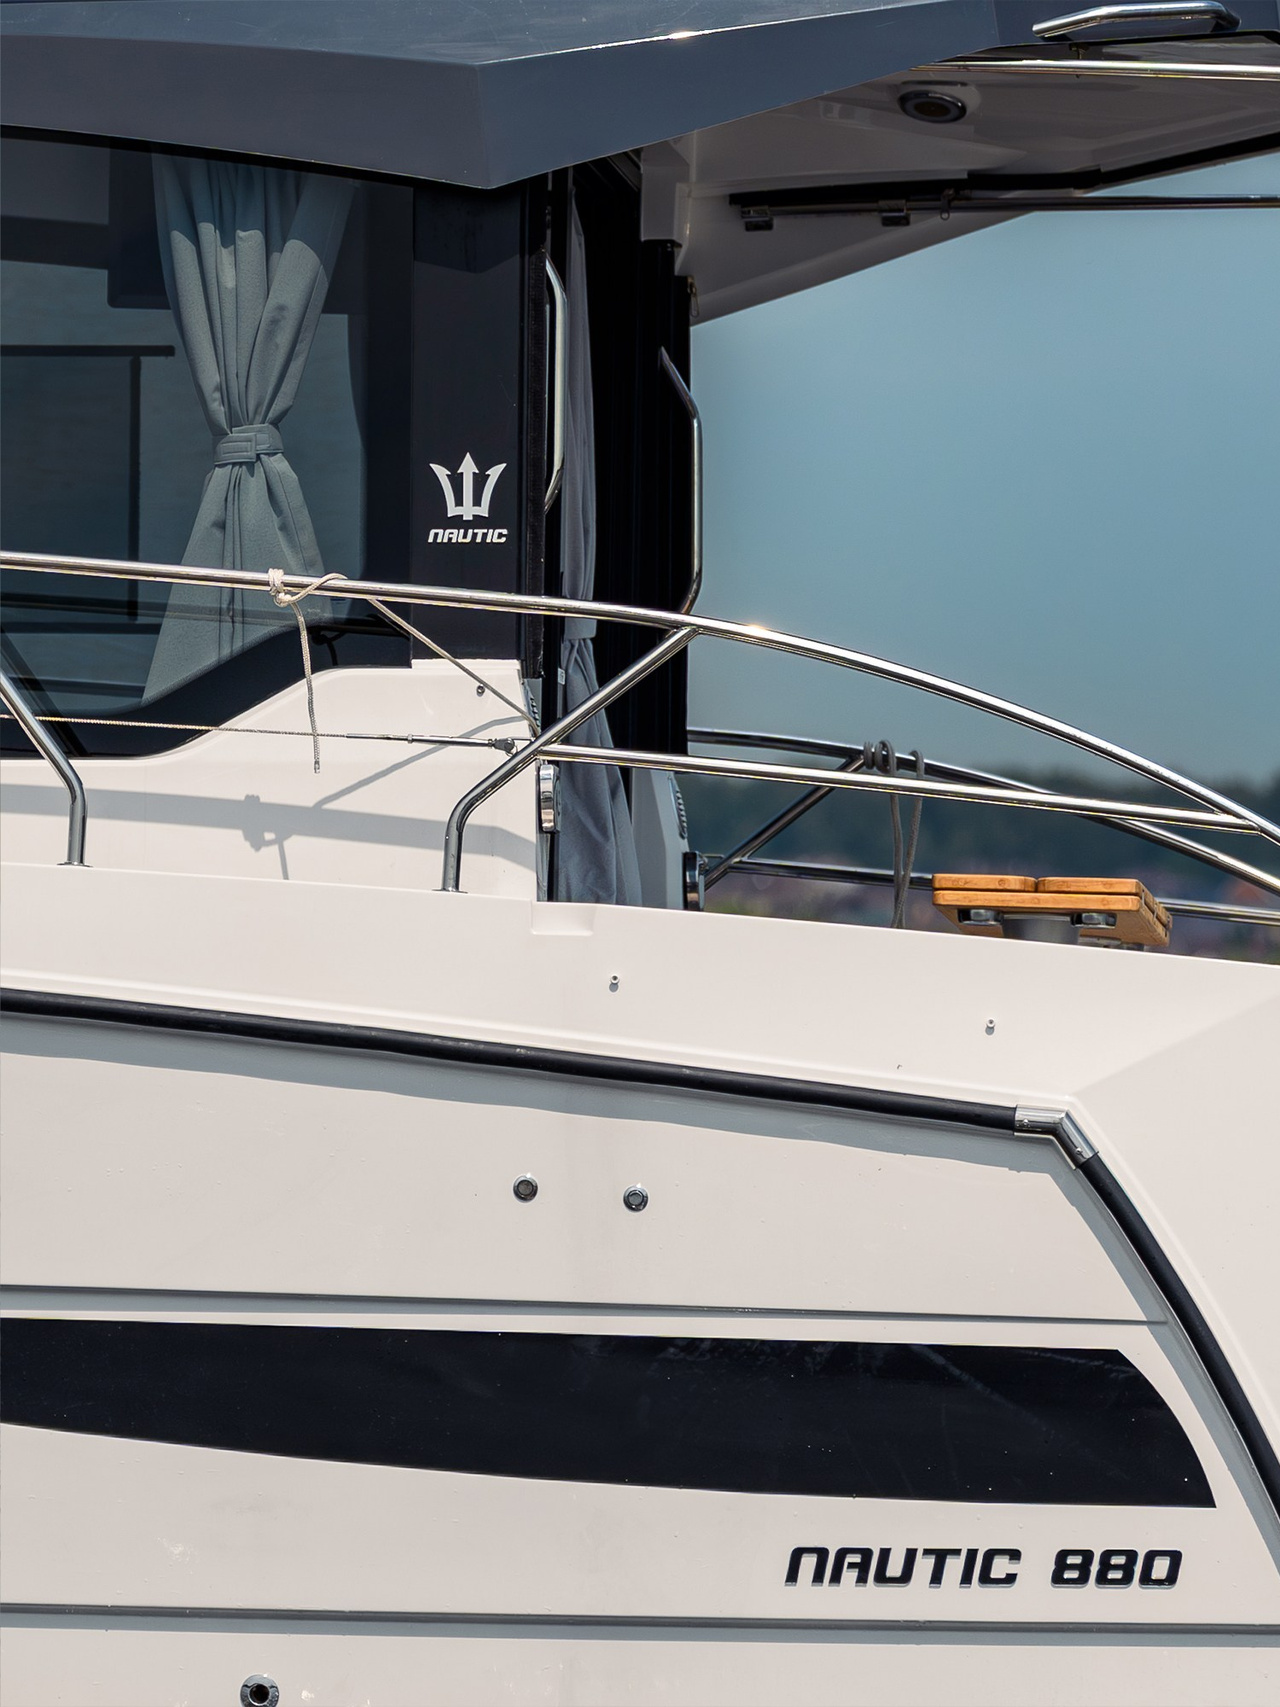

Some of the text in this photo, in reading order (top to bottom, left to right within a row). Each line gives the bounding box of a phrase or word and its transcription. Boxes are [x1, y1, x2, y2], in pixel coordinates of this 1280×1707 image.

[428, 528, 508, 543] NAUTIC
[785, 1546, 1183, 1589] NAUTIC 880
